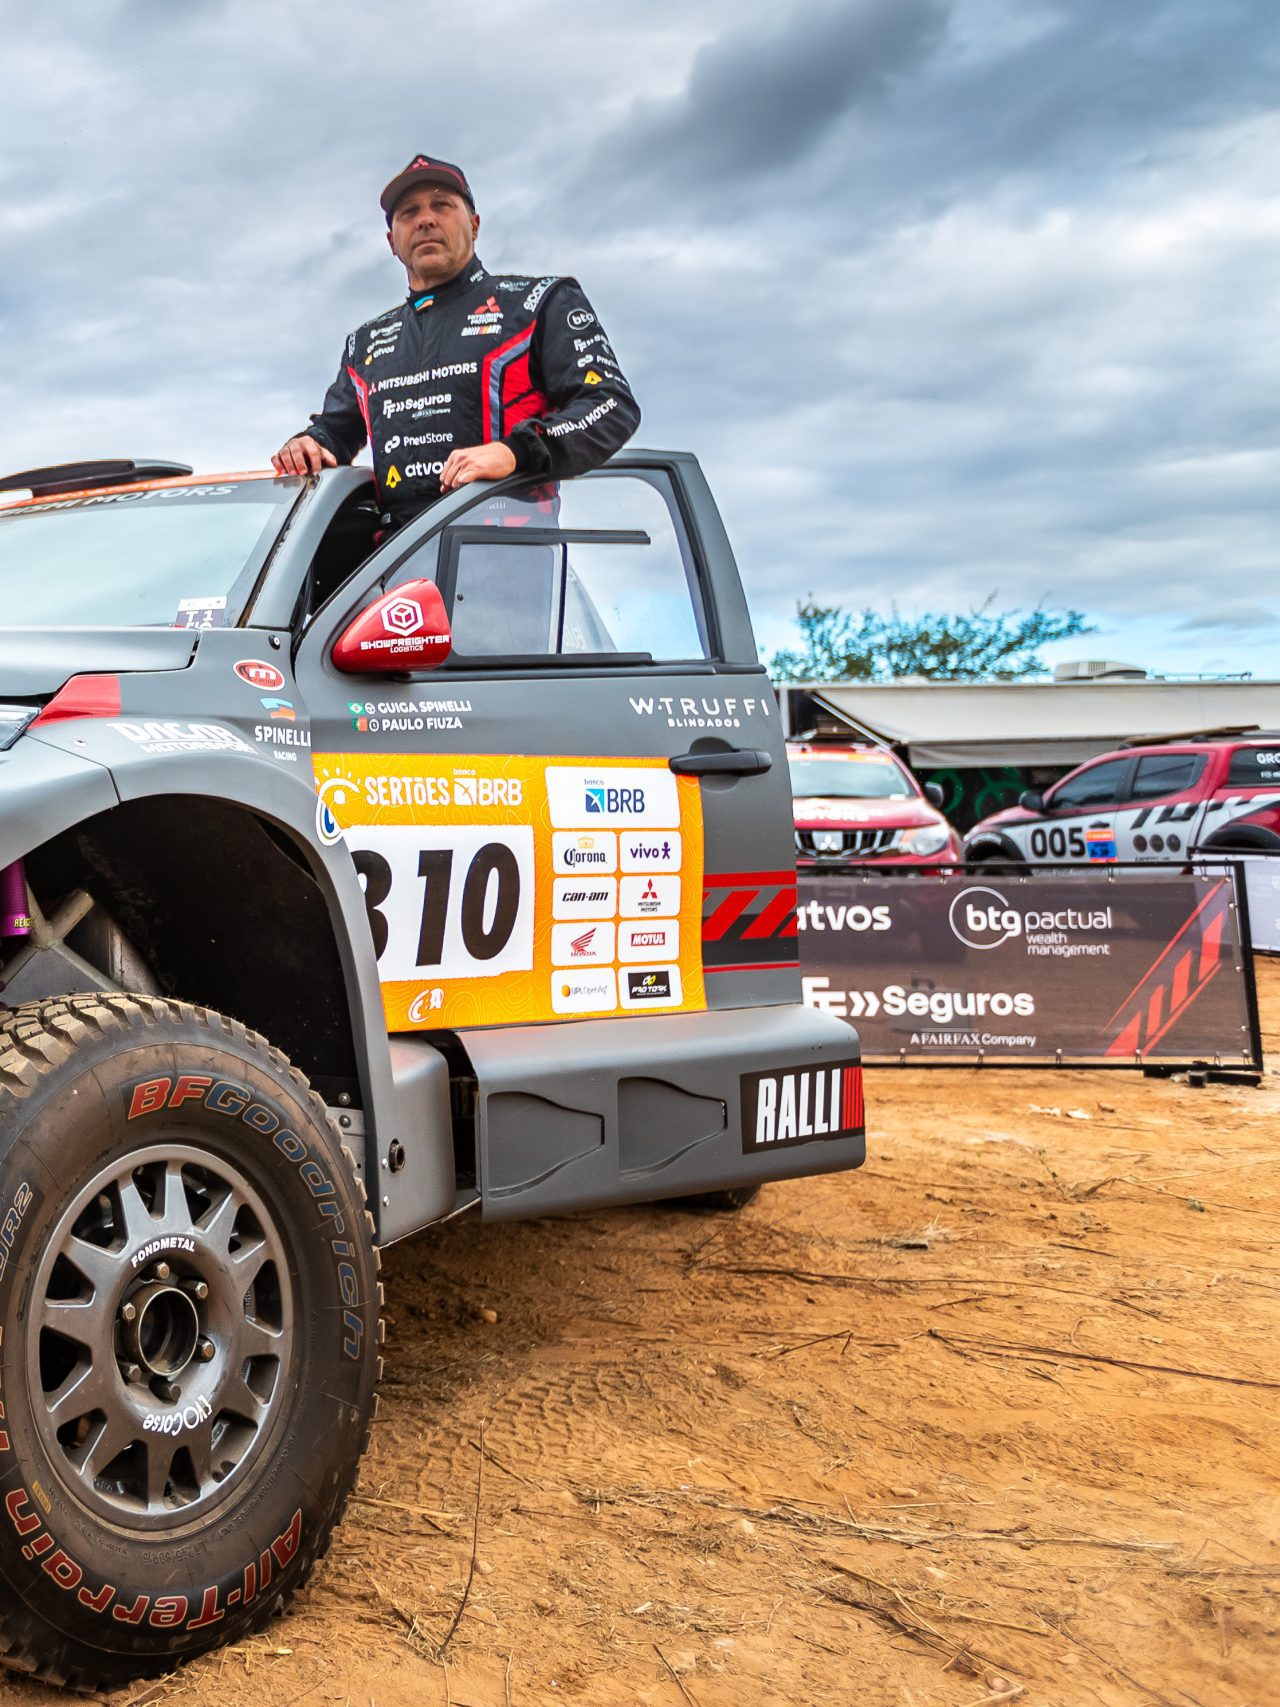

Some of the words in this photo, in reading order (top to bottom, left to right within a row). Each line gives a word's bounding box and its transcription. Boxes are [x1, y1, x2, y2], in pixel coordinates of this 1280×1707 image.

[572, 312, 596, 326] btg
[431, 362, 478, 380] MOTORS
[404, 432, 454, 447] PneuStore
[405, 461, 447, 478] atvo
[360, 635, 450, 650] SHOWFREIGHTER
[390, 645, 424, 653] LOGISTICS
[378, 702, 419, 714] GUIGA
[420, 700, 472, 713] SPINELLI
[382, 718, 423, 731] PAULO
[427, 717, 463, 730] FIUZA
[667, 718, 741, 728] BLINDADOS
[254, 725, 311, 747] SPINELLI
[273, 750, 297, 762] RACING
[478, 778, 523, 806] BRB
[607, 788, 645, 813] BRB
[1031, 827, 1085, 858] 005
[563, 848, 606, 868] Corona
[630, 843, 660, 858] vivo
[562, 891, 609, 902] can-am
[966, 904, 1021, 937] btg
[1024, 907, 1113, 933] pactual
[632, 933, 664, 945] MOTUL
[1026, 933, 1067, 944] wealth
[1027, 944, 1110, 958] management
[882, 985, 1035, 1023] Seguros
[921, 1033, 980, 1045] FAIRFAX
[981, 1033, 1036, 1047] Company
[756, 1068, 840, 1143] RALLI
[131, 1237, 195, 1268] FONDMETAL
[5, 1488, 302, 1630] All-Terrain
